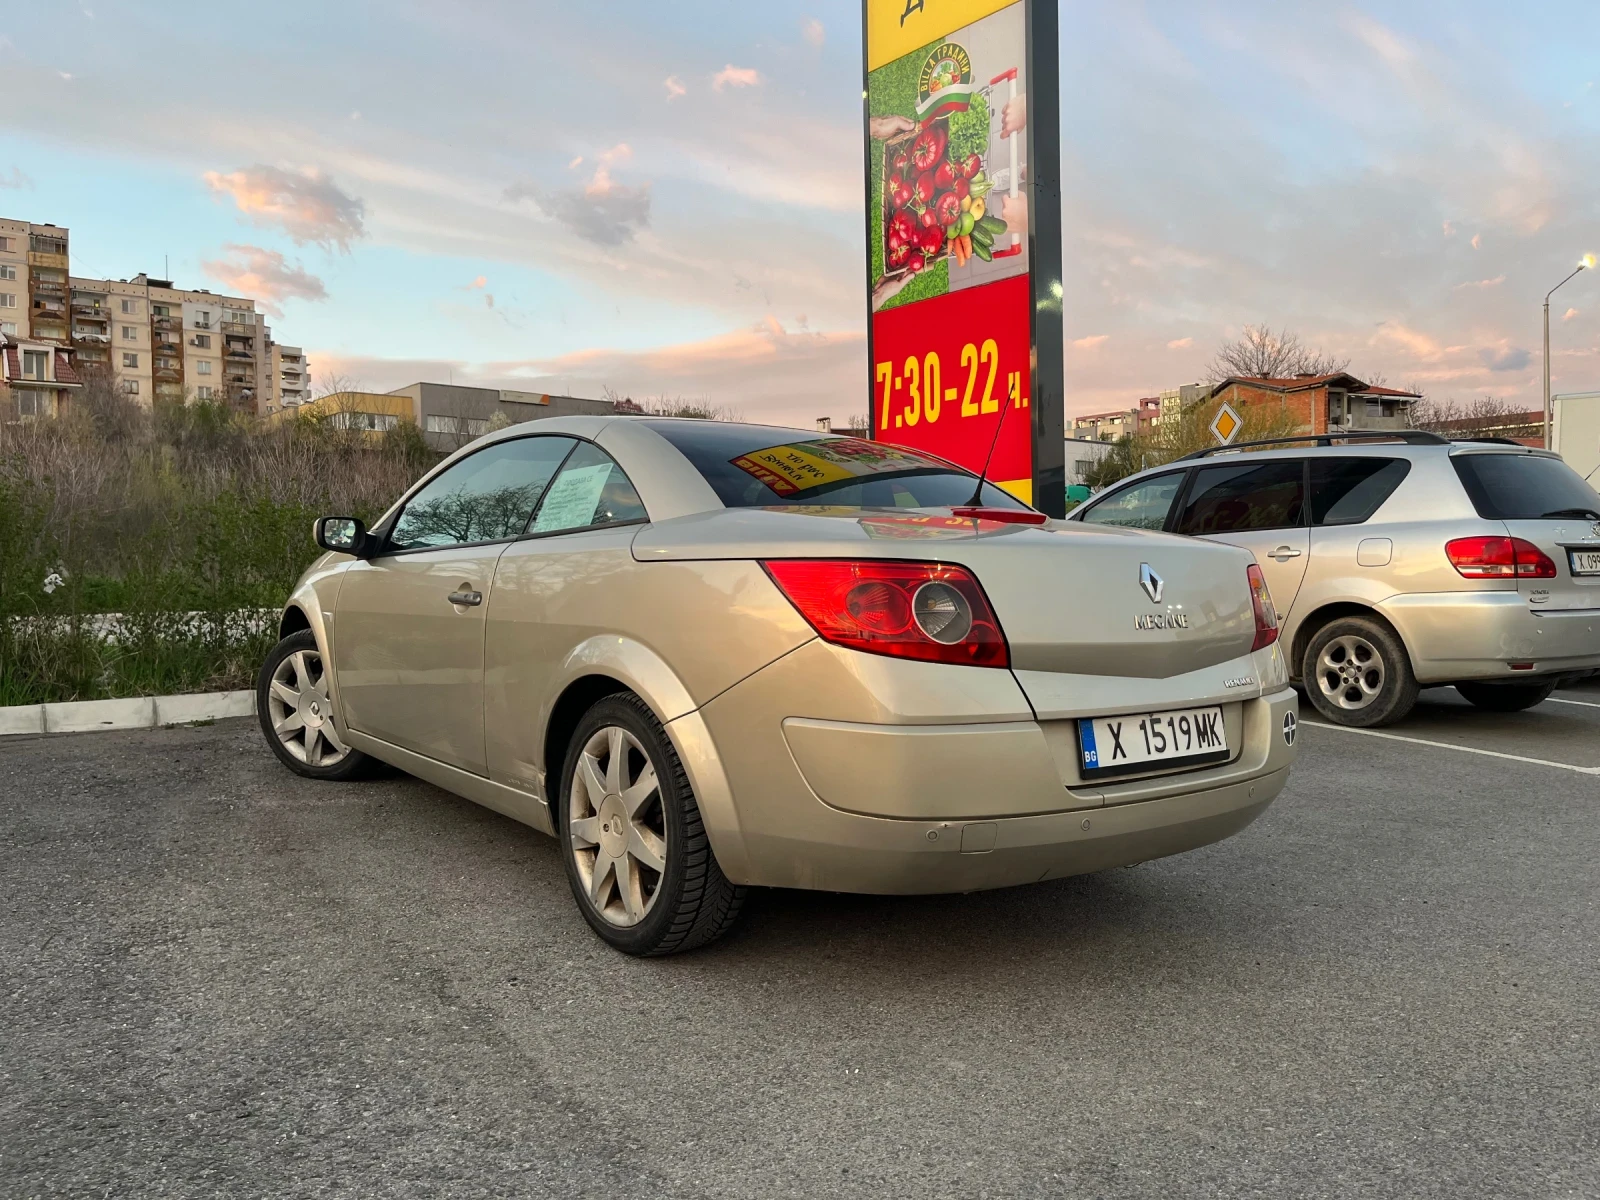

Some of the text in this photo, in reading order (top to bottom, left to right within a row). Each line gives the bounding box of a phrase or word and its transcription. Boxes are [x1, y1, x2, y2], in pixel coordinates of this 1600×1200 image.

[921, 45, 970, 92] BILLA ГРАДИНИ
[1134, 614, 1188, 630] MEGANE
[1107, 721, 1128, 760] X
[1085, 750, 1097, 763] BG
